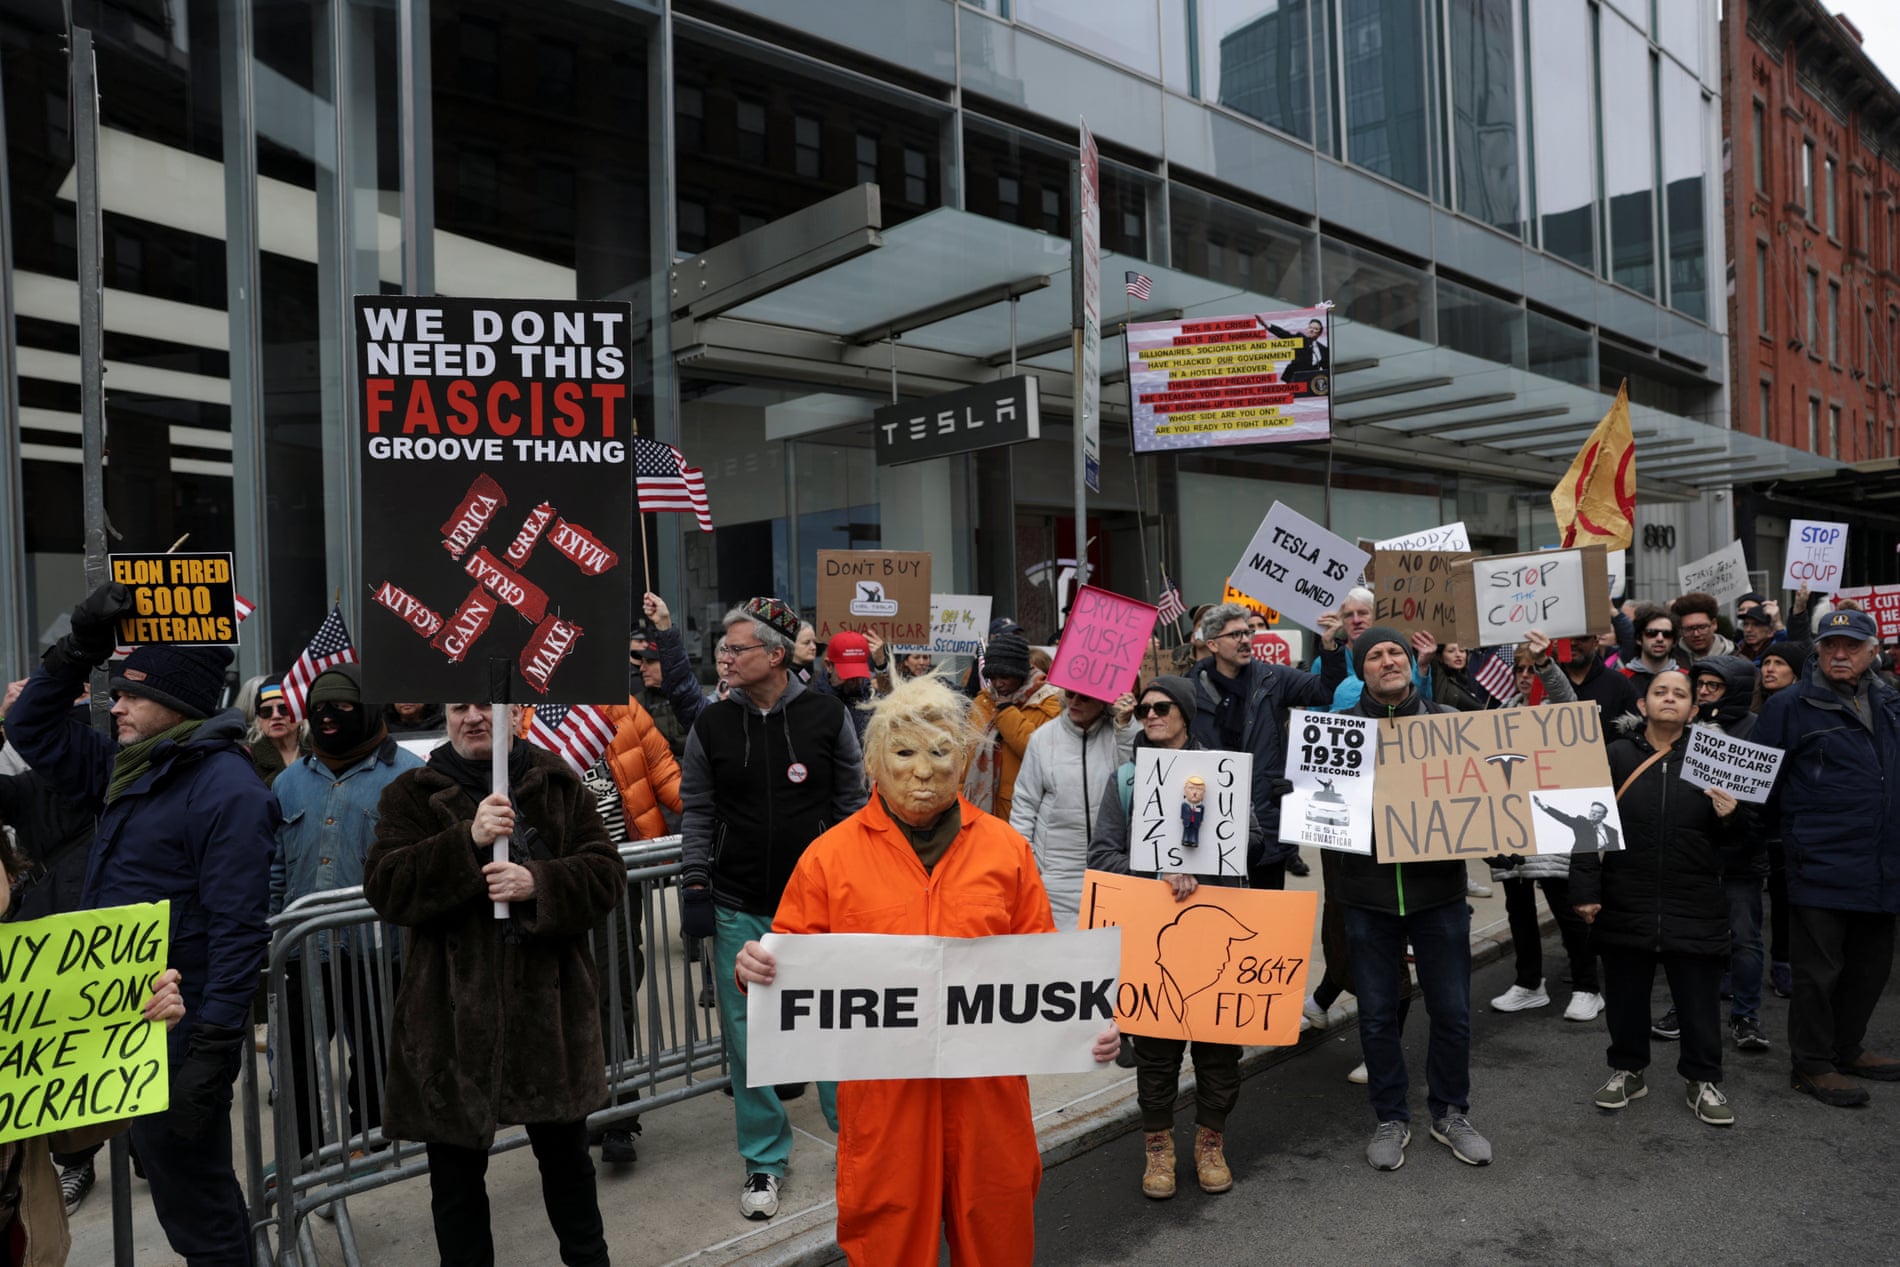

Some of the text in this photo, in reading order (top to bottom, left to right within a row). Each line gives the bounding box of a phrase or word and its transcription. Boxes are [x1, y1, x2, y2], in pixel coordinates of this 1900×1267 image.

[364, 308, 622, 344] WE DONT
[367, 342, 624, 380] NEED THIS
[1148, 350, 1291, 370] HAVE HIJACKED OUR GOVERNMENT
[1197, 344, 1246, 354] SOCIOPATHS
[1250, 342, 1267, 350] AND
[1271, 339, 1295, 348] NAZIS
[1190, 368, 1223, 378] HOSTILE
[366, 378, 626, 438] FASCIST
[1158, 391, 1196, 402] STEALING
[882, 398, 1016, 445] TESLA
[1155, 427, 1169, 436] ARE
[1174, 425, 1190, 434] YOU
[1193, 423, 1218, 432] READY
[1236, 419, 1258, 429] FIGHT
[1263, 417, 1288, 426] BACK?
[1168, 407, 1275, 423] WHOSE SIDE ARE YOU ON?
[368, 437, 624, 463] GROOVE THANG
[554, 523, 610, 572] MAKE
[1381, 529, 1454, 550] NOBODY
[1801, 526, 1840, 544] STOP
[826, 558, 920, 578] DON'T BUY
[1272, 527, 1348, 580] TESLA IS
[1399, 553, 1423, 573] NO
[1804, 546, 1834, 562] THE
[114, 559, 230, 584] ELON FIRED
[1249, 552, 1334, 608] NAZI OWNED
[1490, 561, 1559, 588] STOP
[1790, 561, 1838, 582] COUP
[136, 586, 211, 616] 6000
[1080, 591, 1143, 628] DRIVE
[1512, 590, 1536, 600] THE
[1874, 594, 1900, 608] CUT
[1376, 597, 1456, 626] ELON MUS
[1488, 596, 1560, 626] COUP
[1881, 610, 1900, 622] HE
[122, 616, 232, 642] VETERANS
[444, 600, 489, 654] GAIN
[821, 622, 830, 638] A
[840, 622, 926, 640] SWASTICAR
[1067, 619, 1138, 664] MUSK
[526, 622, 574, 683] MAKE
[1251, 642, 1286, 657] TOP
[1068, 654, 1128, 691] OUT
[1303, 724, 1364, 748] 0 TO
[1304, 716, 1366, 728] GOES FROM
[1378, 706, 1600, 765] HONK IF YOU
[1302, 745, 1362, 768] 1939
[1694, 732, 1778, 764] STOP BUYING
[1694, 742, 1772, 774] SWASTICARS
[1300, 764, 1310, 772] IN
[1318, 766, 1360, 778] SECONDS
[1422, 750, 1560, 798] HATE
[1686, 756, 1772, 788] GRAB HIM BY THE
[1692, 768, 1758, 794] STOCK PRICE
[1305, 824, 1348, 836] TESLA
[1385, 794, 1528, 858] NAZIS
[56, 920, 162, 976] DRUG
[1236, 956, 1303, 985] 8647
[0, 989, 56, 1034] AIL
[780, 978, 1115, 1030] FIRE MUSK
[1112, 982, 1164, 1022] ON
[1216, 992, 1283, 1031] FDT
[0, 1019, 150, 1078] AKE TO
